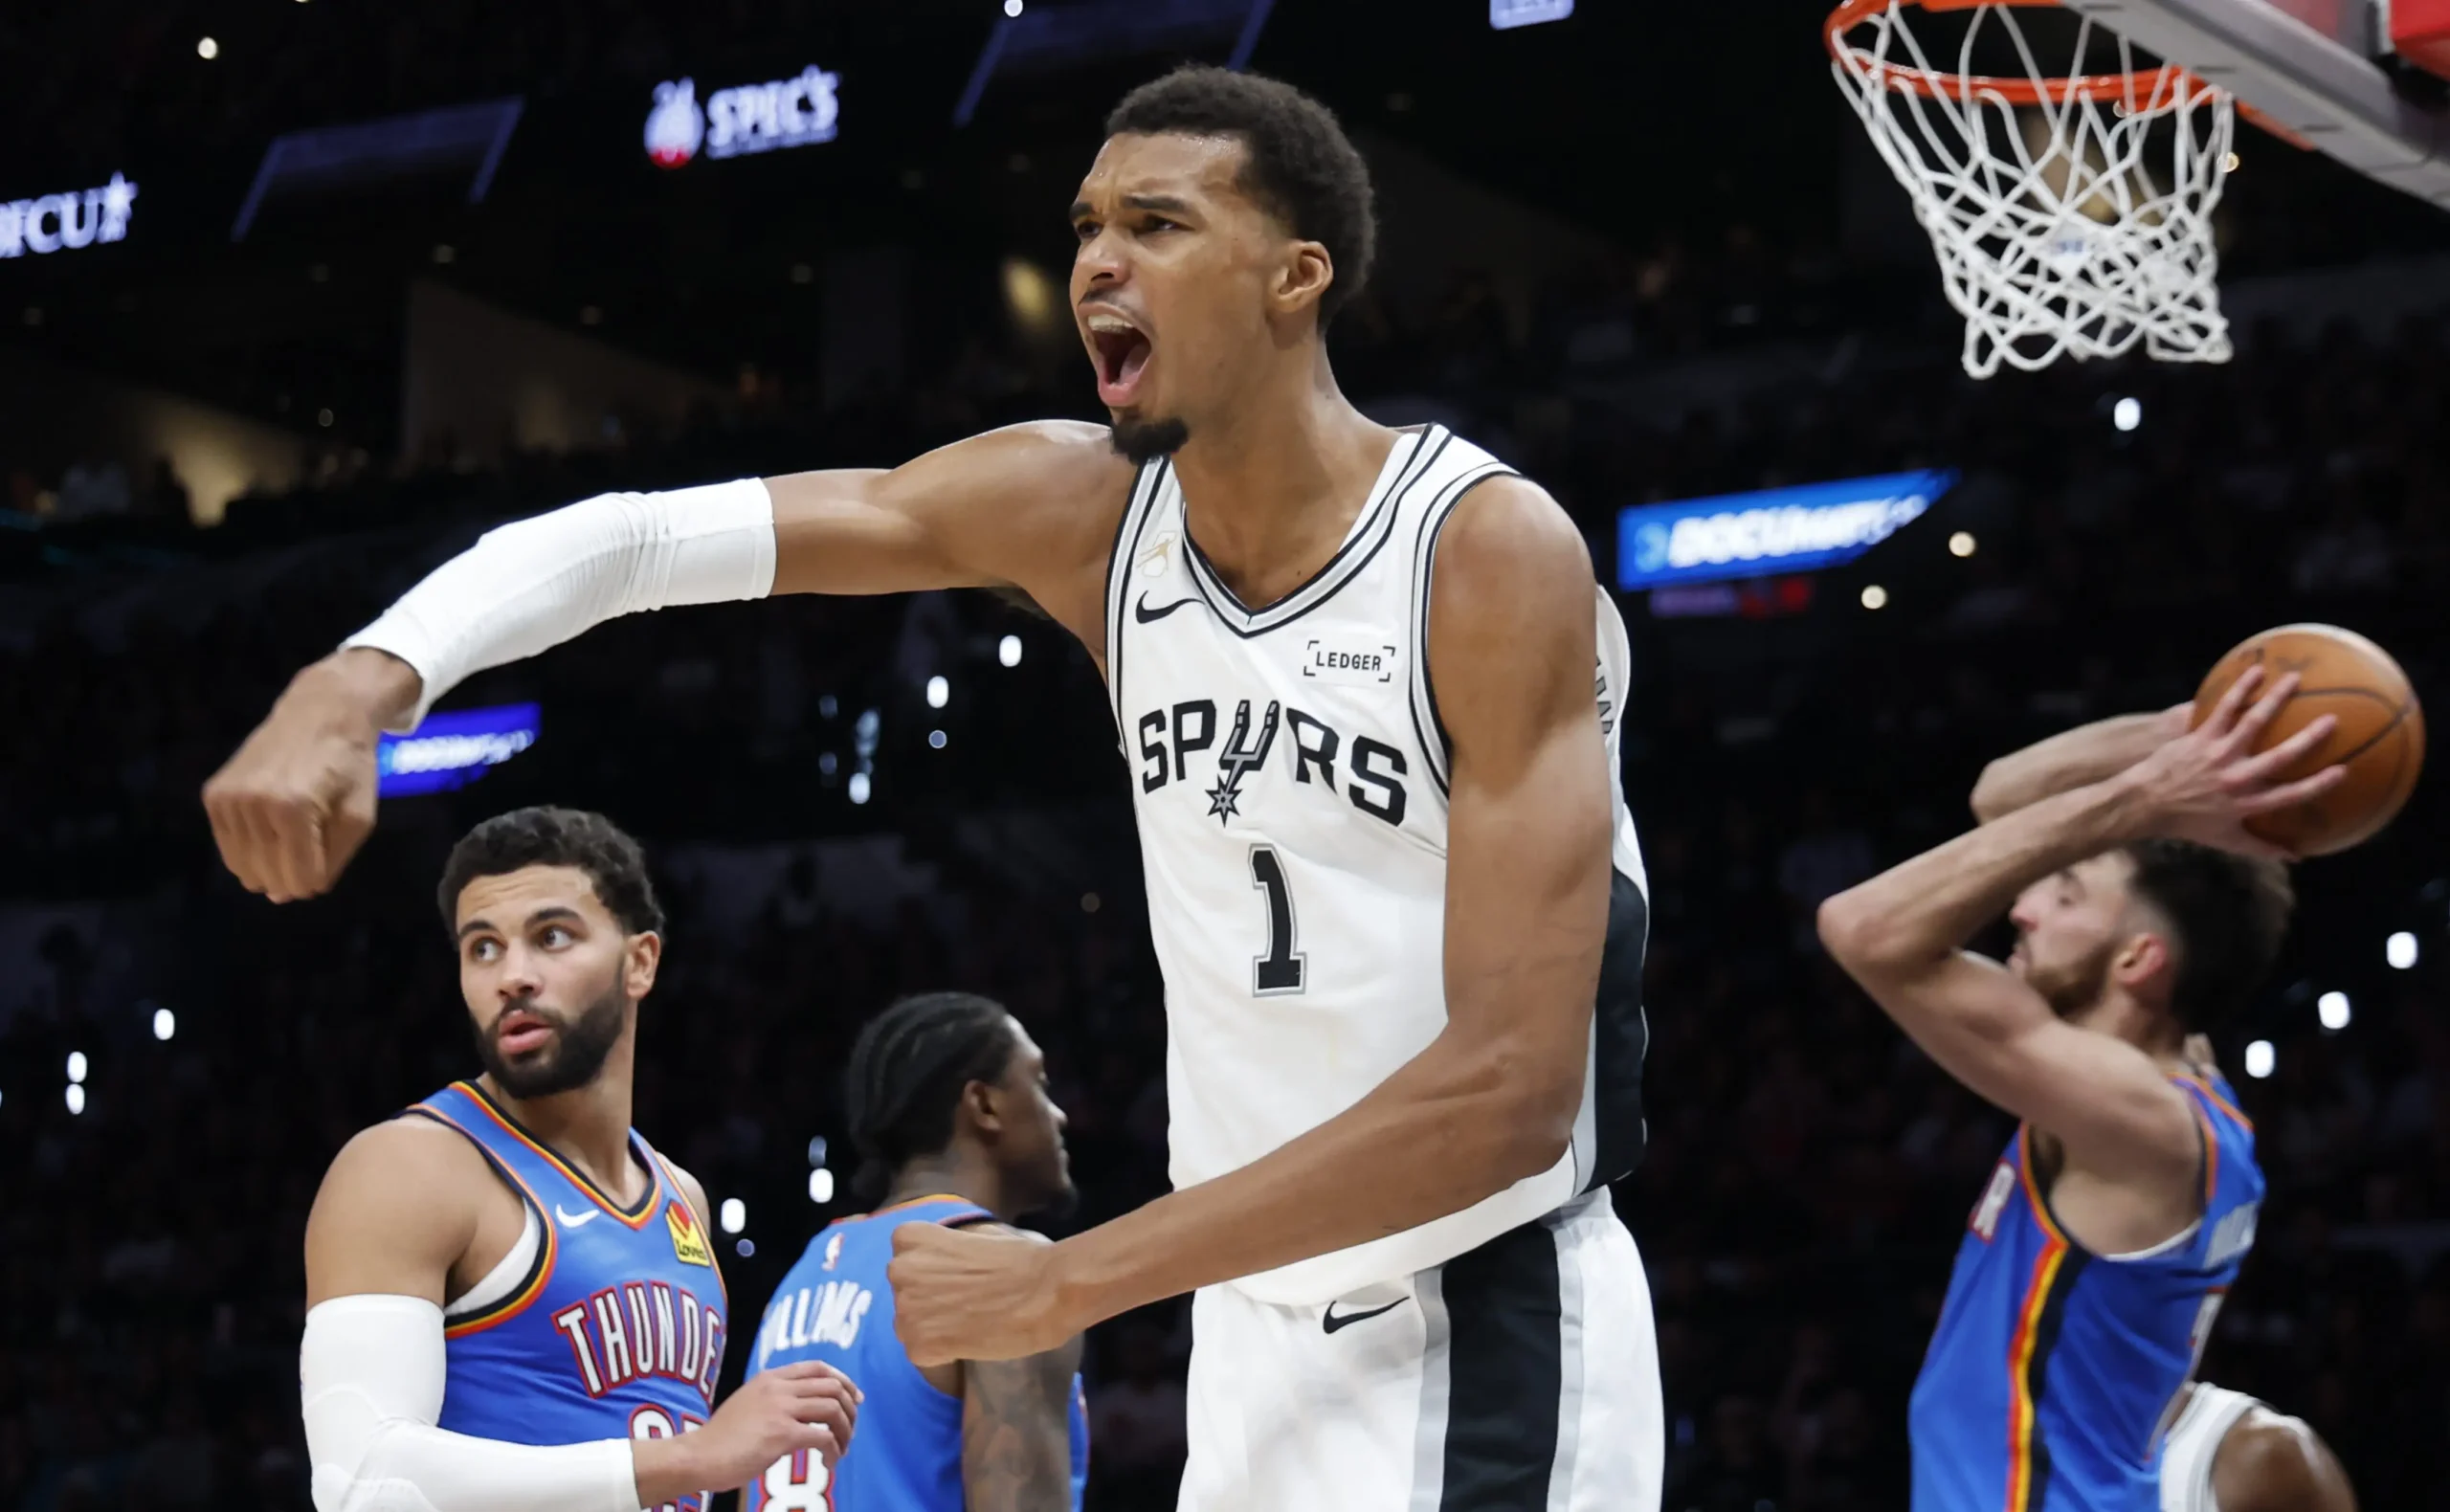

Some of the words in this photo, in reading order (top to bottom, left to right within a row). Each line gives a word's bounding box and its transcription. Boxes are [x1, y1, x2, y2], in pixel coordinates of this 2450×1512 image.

[1316, 651, 1382, 672] LEDGER
[1139, 699, 1408, 828] SPURS
[1248, 843, 1307, 998] 1
[550, 1279, 726, 1409] THUNDE
